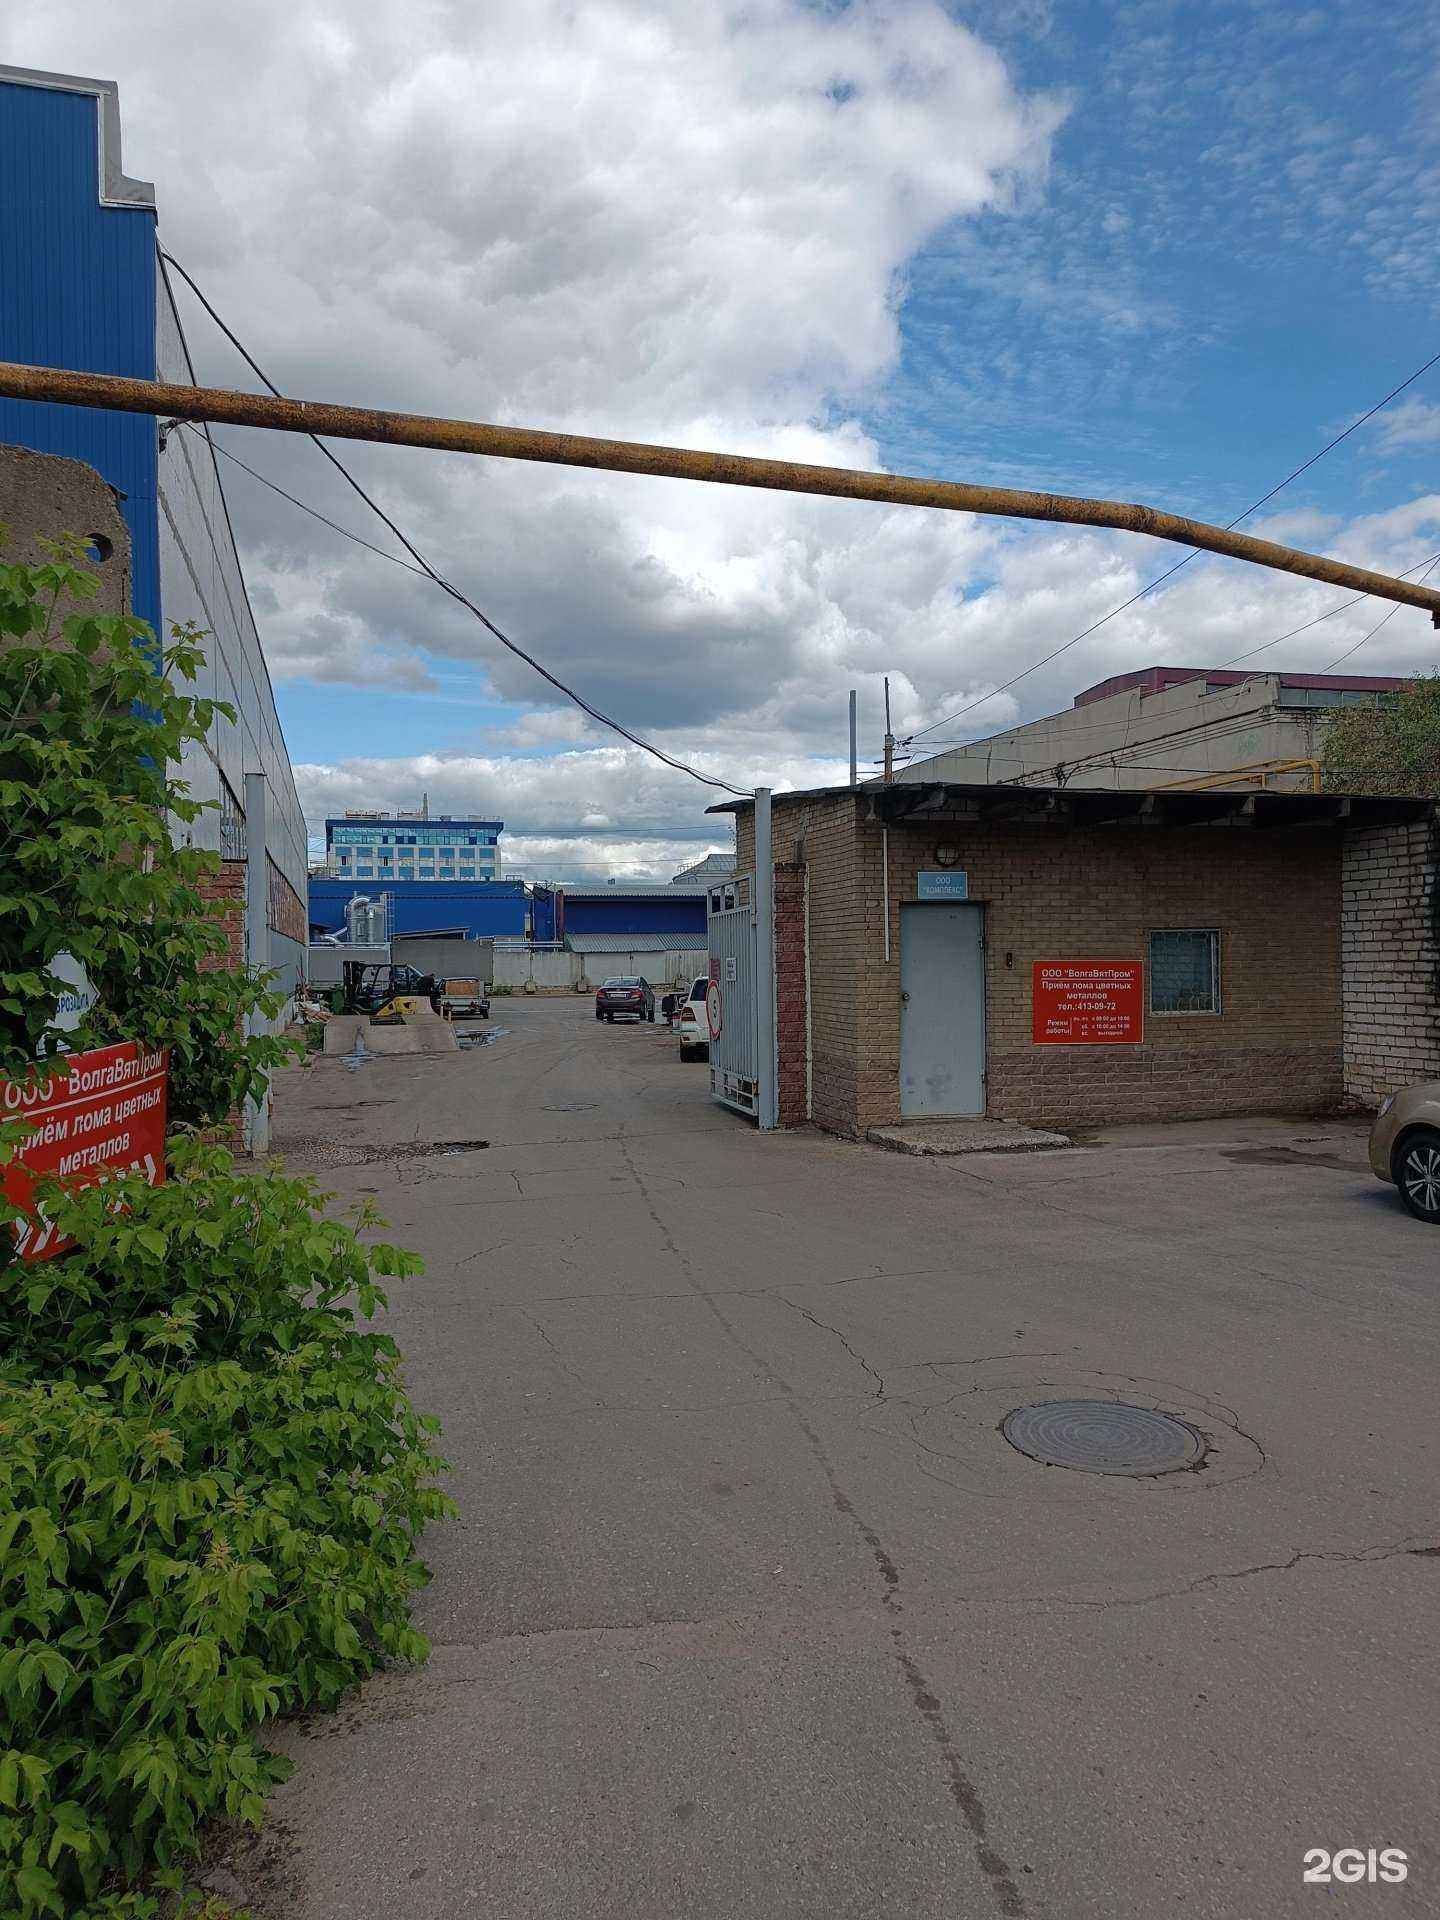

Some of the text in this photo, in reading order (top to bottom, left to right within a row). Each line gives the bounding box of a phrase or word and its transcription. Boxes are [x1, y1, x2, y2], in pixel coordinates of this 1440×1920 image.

[935, 876, 951, 885] ООО
[1041, 969, 1135, 979] ООО "ВолгаВятПром"
[1072, 982, 1094, 990] лома
[1095, 982, 1132, 991] цветных
[1066, 992, 1108, 1000] металлов
[72, 1105, 112, 1137] лома
[114, 1086, 162, 1126] цветных
[58, 1132, 130, 1177] металлов
